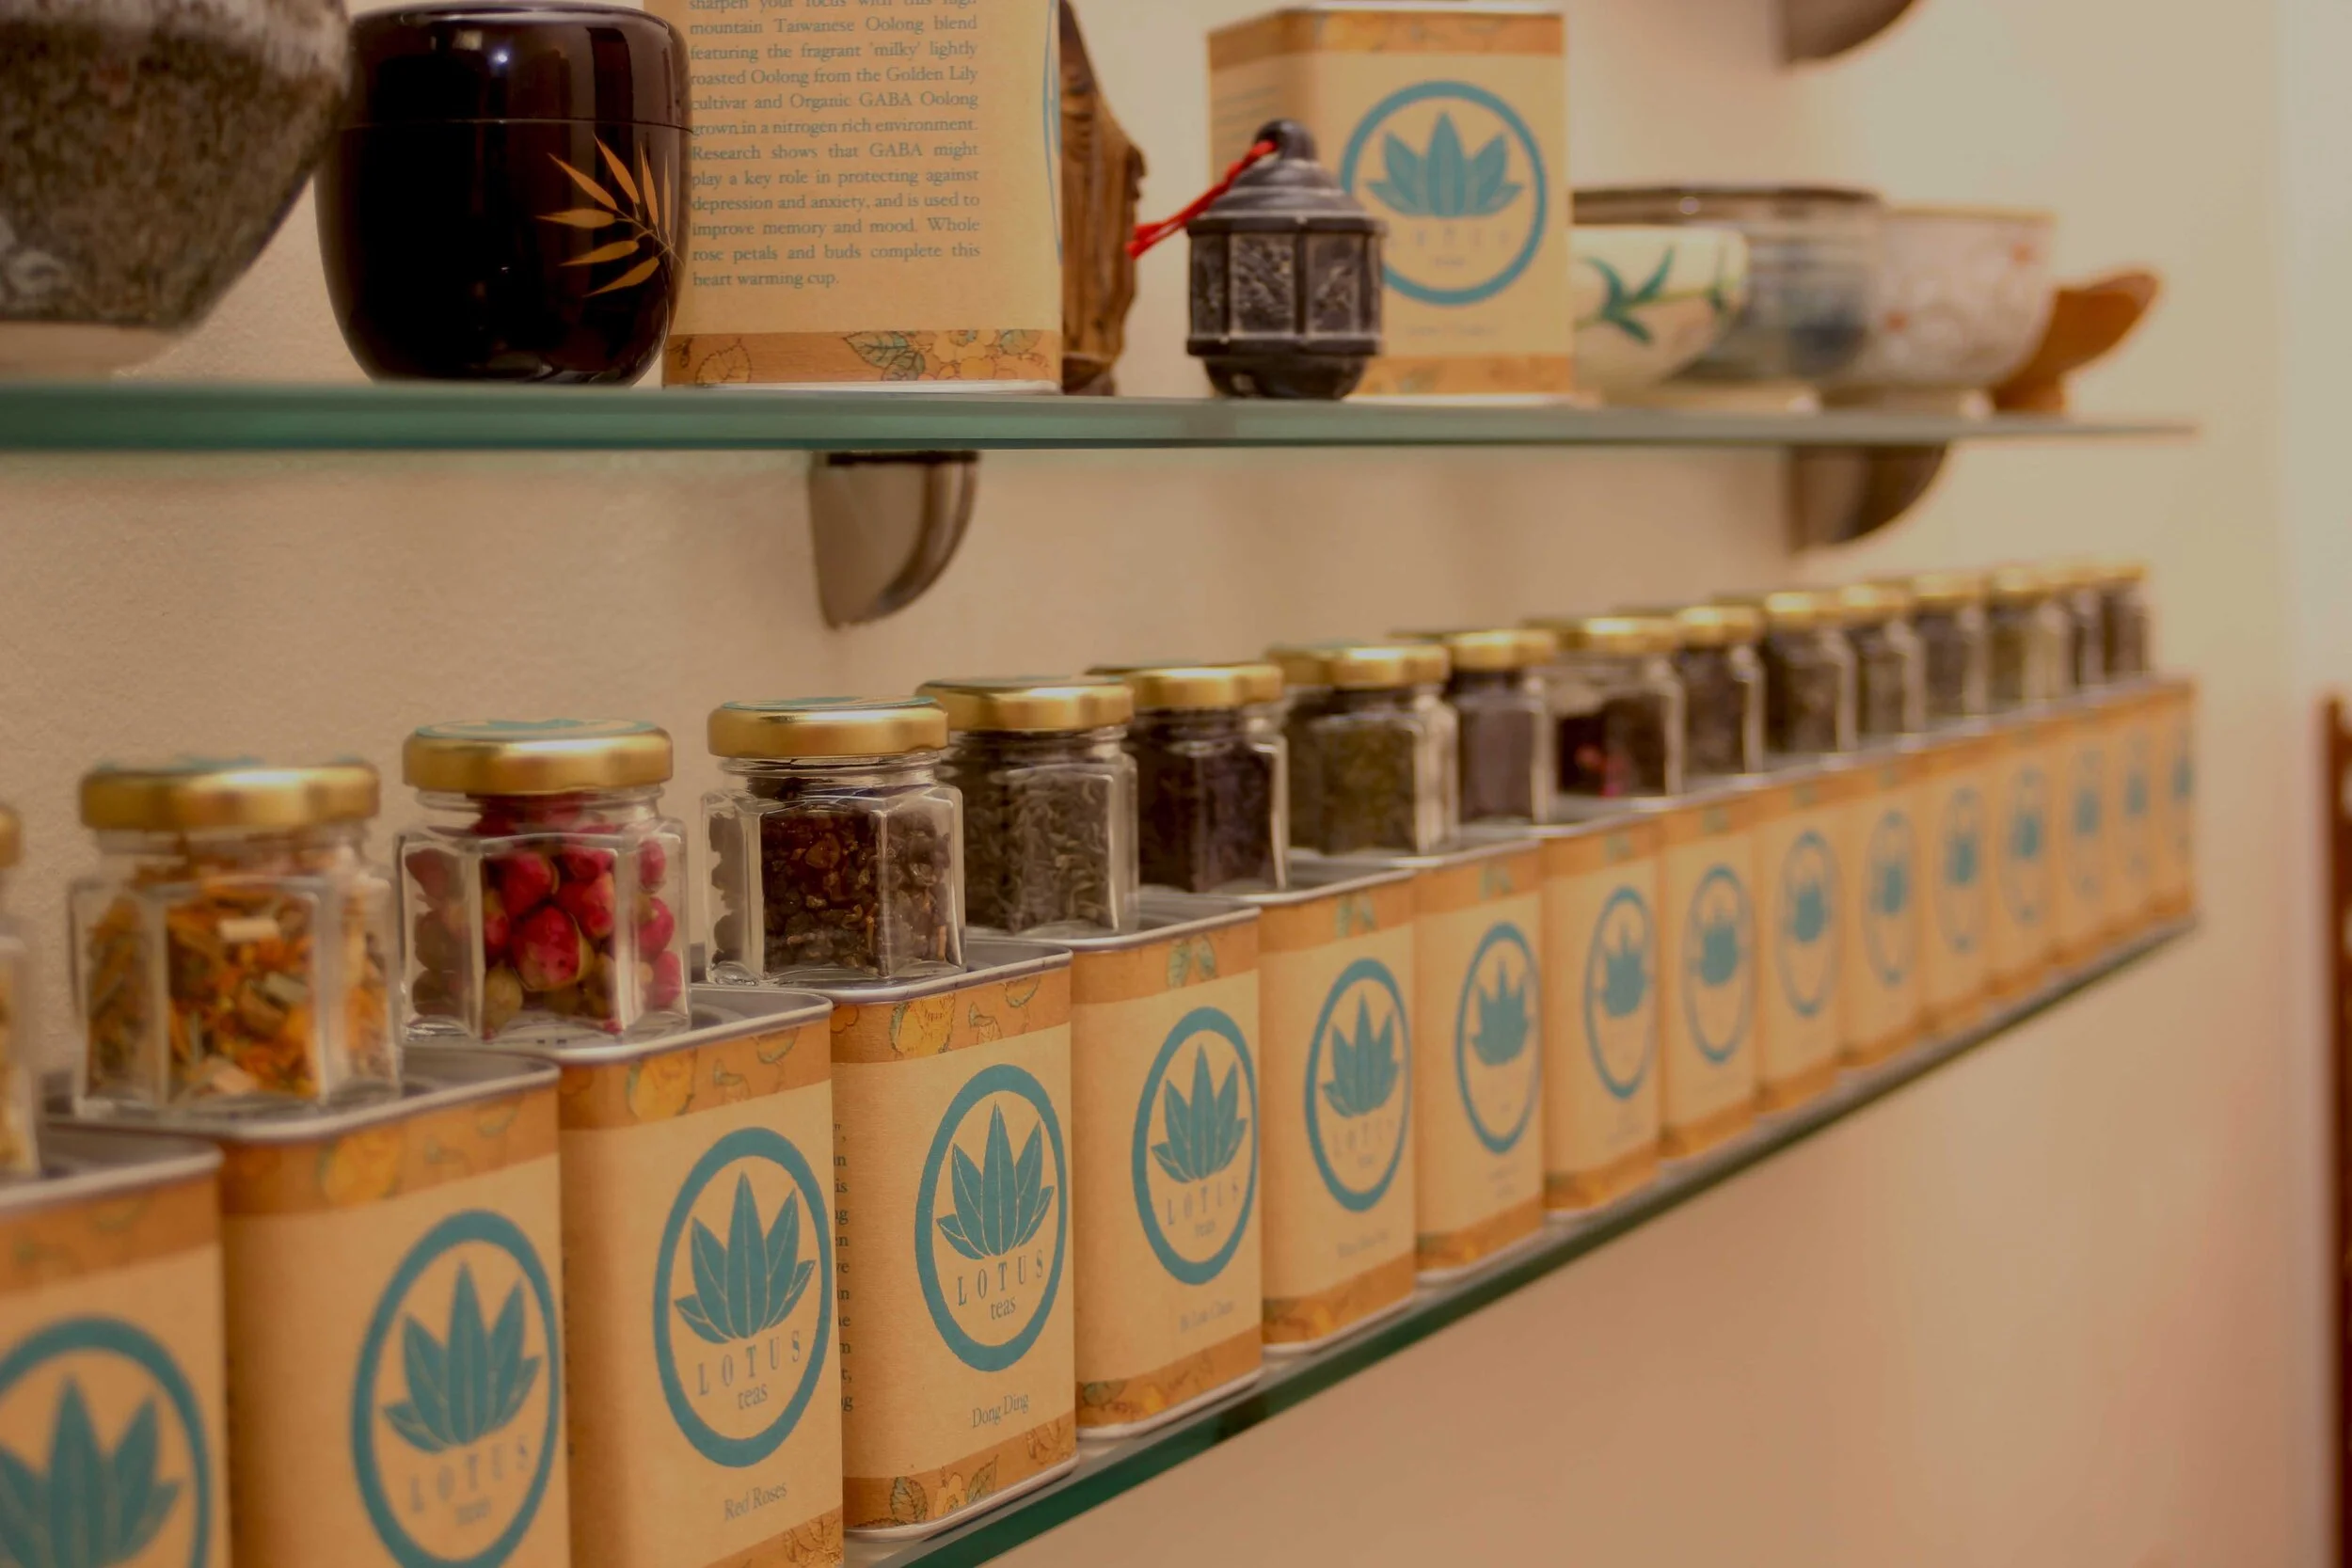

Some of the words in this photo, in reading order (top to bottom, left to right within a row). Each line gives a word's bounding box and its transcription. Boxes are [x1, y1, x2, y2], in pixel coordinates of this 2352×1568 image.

[690, 20, 762, 35] mountain
[773, 18, 854, 33] Taiwanese
[866, 16, 923, 35] Oolong
[934, 15, 977, 30] blend
[690, 44, 758, 63] featuring
[768, 43, 791, 57] the
[802, 42, 861, 62] fragrant
[869, 40, 920, 61] 'milky'
[930, 40, 977, 59] lightly
[691, 70, 746, 86] roasted
[751, 69, 809, 87] Oolong
[814, 68, 850, 83] from
[857, 68, 881, 82] the
[886, 67, 943, 81] Golden
[949, 65, 977, 85] Lily
[691, 95, 746, 110] cultivar
[755, 94, 783, 109] and
[790, 93, 851, 112] Organic
[859, 92, 912, 107] GABA
[920, 91, 977, 110] Oolong
[691, 123, 738, 140] grown
[741, 120, 756, 135] in
[761, 123, 769, 133] a
[773, 120, 836, 138] nitrogen
[842, 118, 871, 133] rich
[875, 117, 978, 132] environment.
[691, 145, 760, 161] Research
[771, 144, 818, 159] shows
[829, 143, 858, 158] that
[869, 142, 923, 157] GABA
[934, 141, 978, 161] might
[691, 171, 722, 190] play
[729, 175, 738, 185] a
[744, 170, 771, 189] key
[779, 169, 808, 184] role
[817, 168, 830, 183] in
[838, 168, 919, 188] protecting
[926, 166, 979, 186] against
[691, 196, 773, 215] depression
[778, 194, 805, 209] and
[811, 194, 871, 213] anxiety,
[875, 193, 903, 208] and
[908, 193, 919, 207] is
[925, 192, 959, 207] used
[963, 194, 980, 206] to
[691, 222, 755, 240] improve
[763, 223, 826, 238] memory
[834, 218, 862, 233] and
[869, 217, 918, 233] mood.
[927, 216, 980, 231] Whole
[692, 249, 724, 261] rose
[733, 245, 778, 264] petals
[787, 245, 816, 260] and
[824, 243, 862, 259] buds
[870, 243, 943, 262] complete
[951, 242, 980, 257] this
[692, 272, 732, 286] heart
[738, 271, 804, 290] warming
[807, 273, 840, 288] cup.
[957, 1249, 1043, 1307] LOTUS
[990, 1296, 1017, 1320] teas
[697, 1329, 801, 1396] LOTUS
[738, 1384, 768, 1410] teas
[972, 1406, 1001, 1429] Dong
[1003, 1393, 1029, 1415] Ding
[723, 1491, 750, 1521] Red
[751, 1481, 788, 1510] Roses
